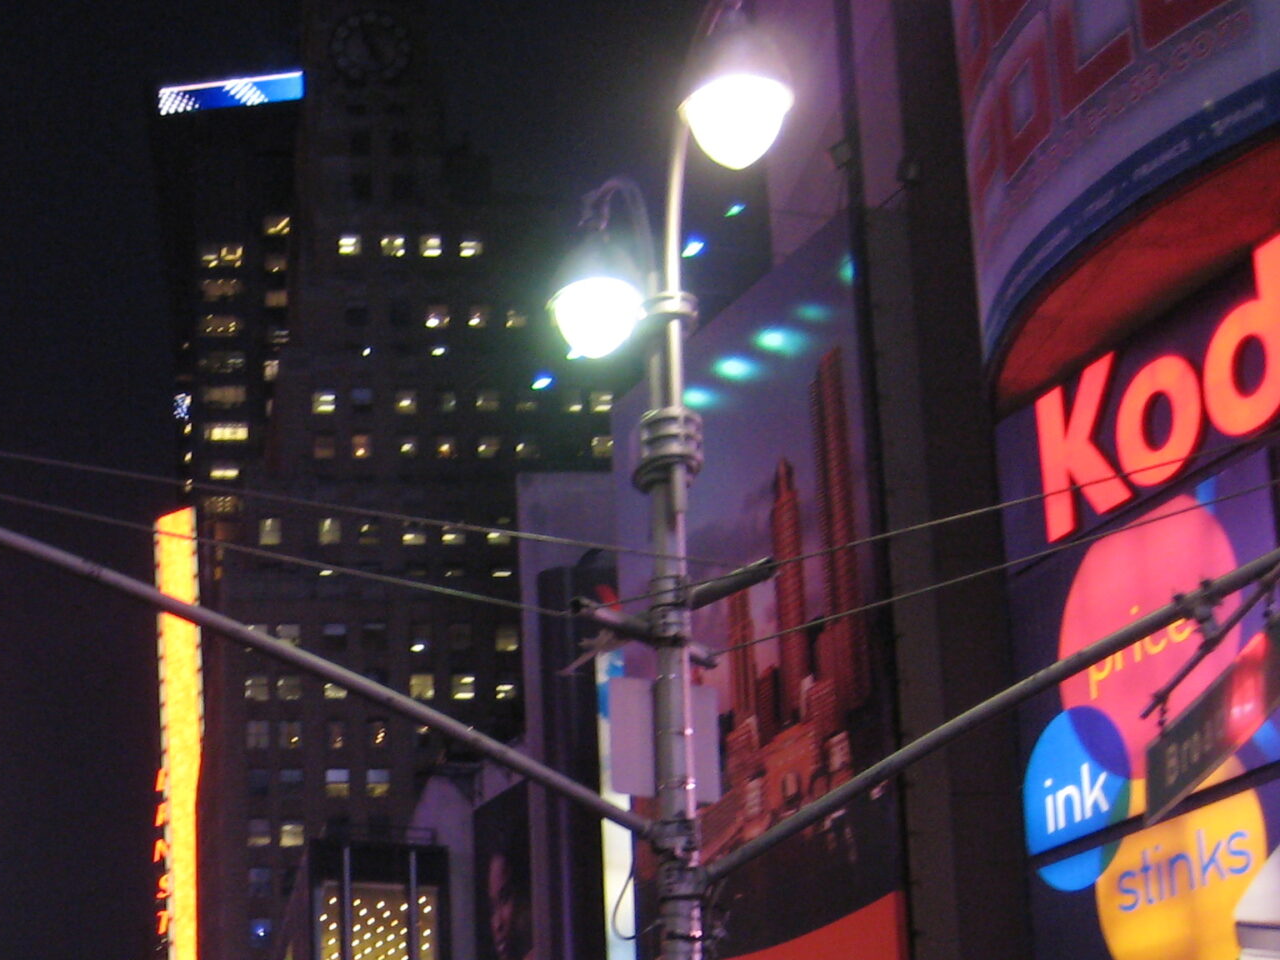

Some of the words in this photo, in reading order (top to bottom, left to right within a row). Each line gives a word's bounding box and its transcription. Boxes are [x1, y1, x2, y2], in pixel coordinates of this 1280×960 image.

[1088, 605, 1197, 700] price
[1044, 762, 1111, 836] ink
[1116, 830, 1253, 912] stinks
